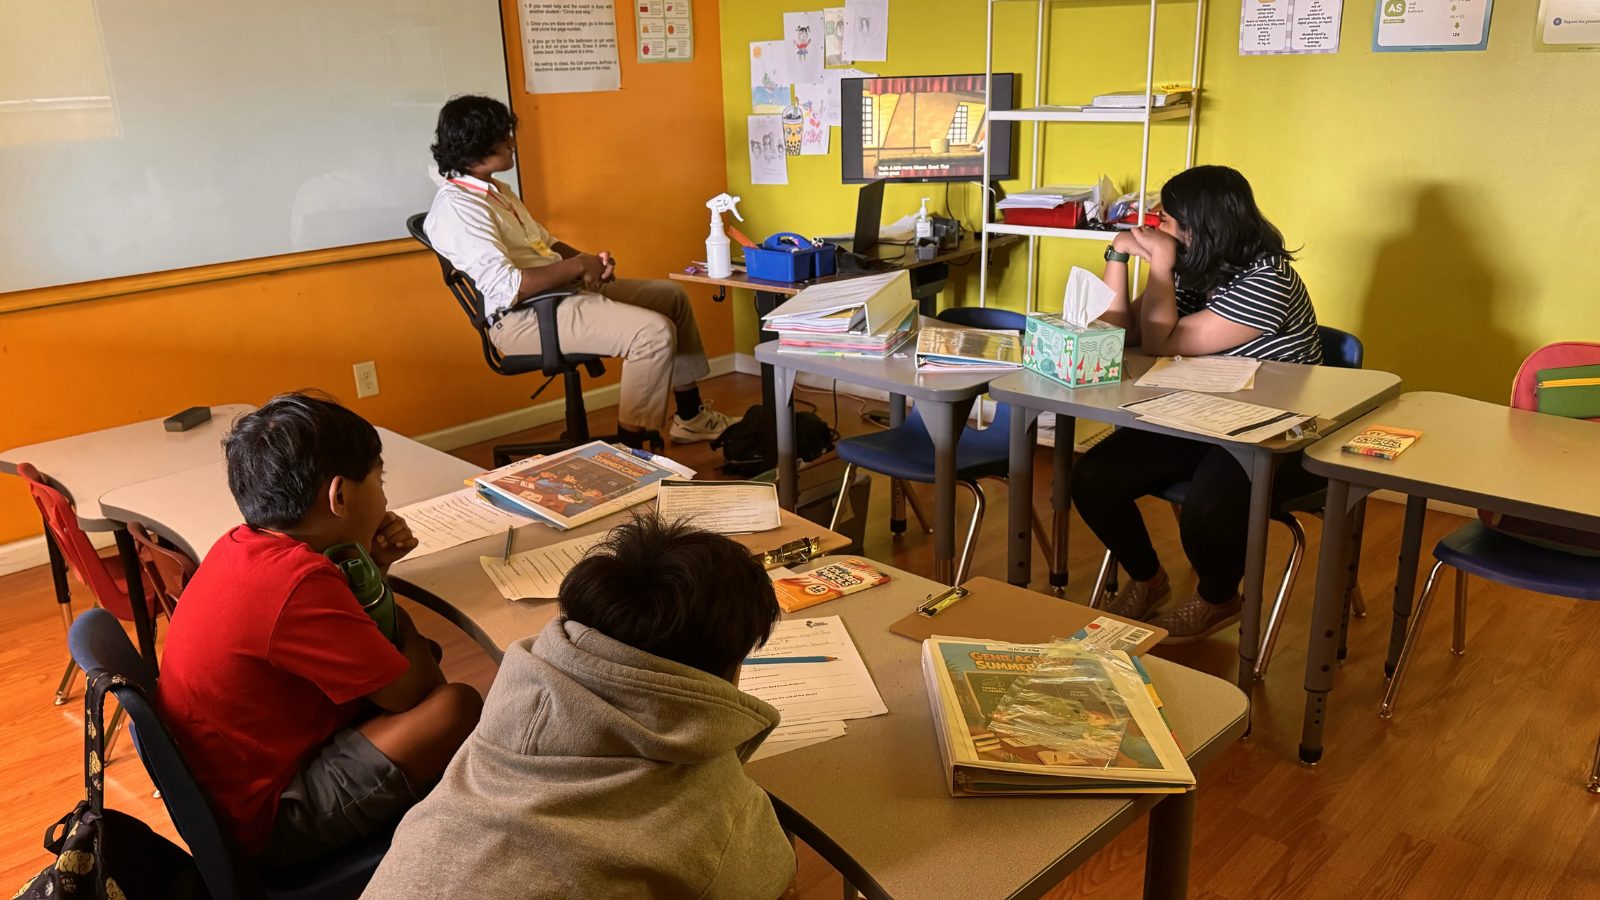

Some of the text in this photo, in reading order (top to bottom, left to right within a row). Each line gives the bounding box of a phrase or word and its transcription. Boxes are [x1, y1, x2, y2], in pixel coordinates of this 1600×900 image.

[1388, 4, 1403, 13] AS
[705, 418, 718, 430] N
[969, 652, 1013, 662] GENIE
[976, 660, 1035, 672] SUMMER
